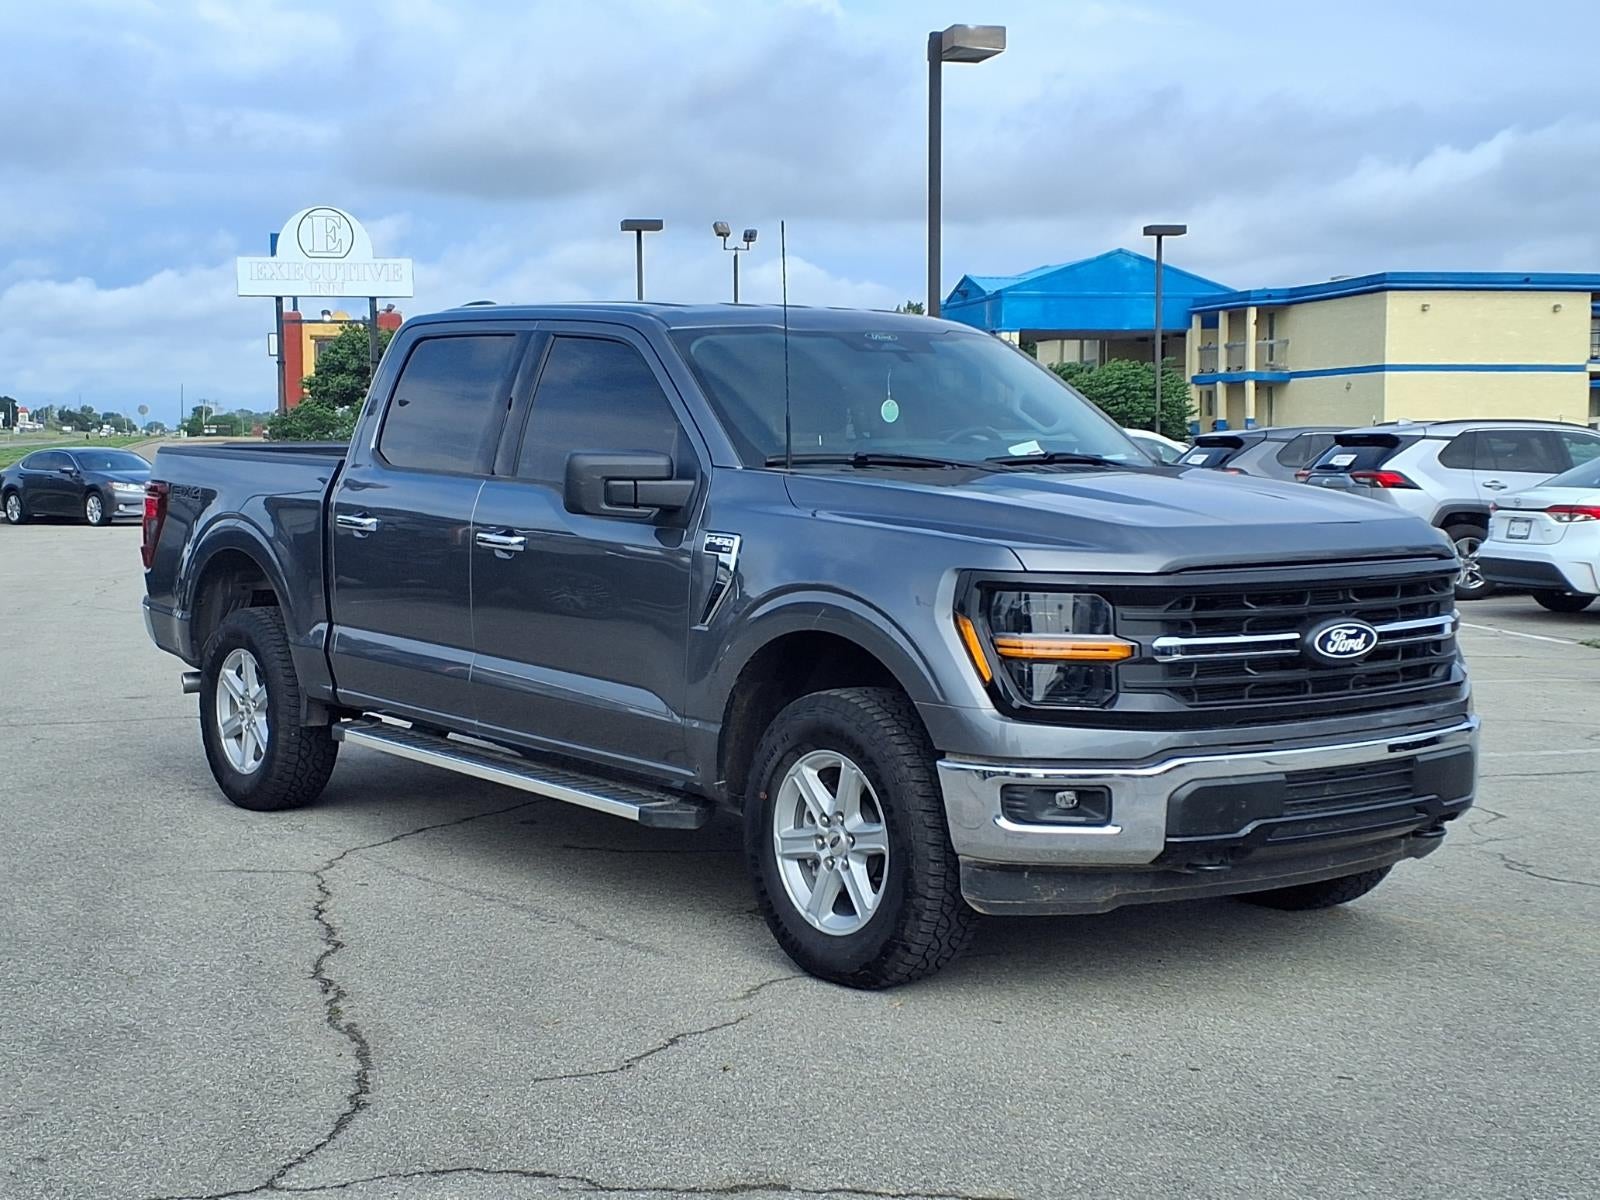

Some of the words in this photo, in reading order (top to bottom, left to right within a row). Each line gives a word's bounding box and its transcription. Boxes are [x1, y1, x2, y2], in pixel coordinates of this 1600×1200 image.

[308, 215, 342, 253] E
[250, 262, 402, 281] EXECUTIVE
[309, 282, 345, 295] INN
[1326, 629, 1366, 653] Ford
